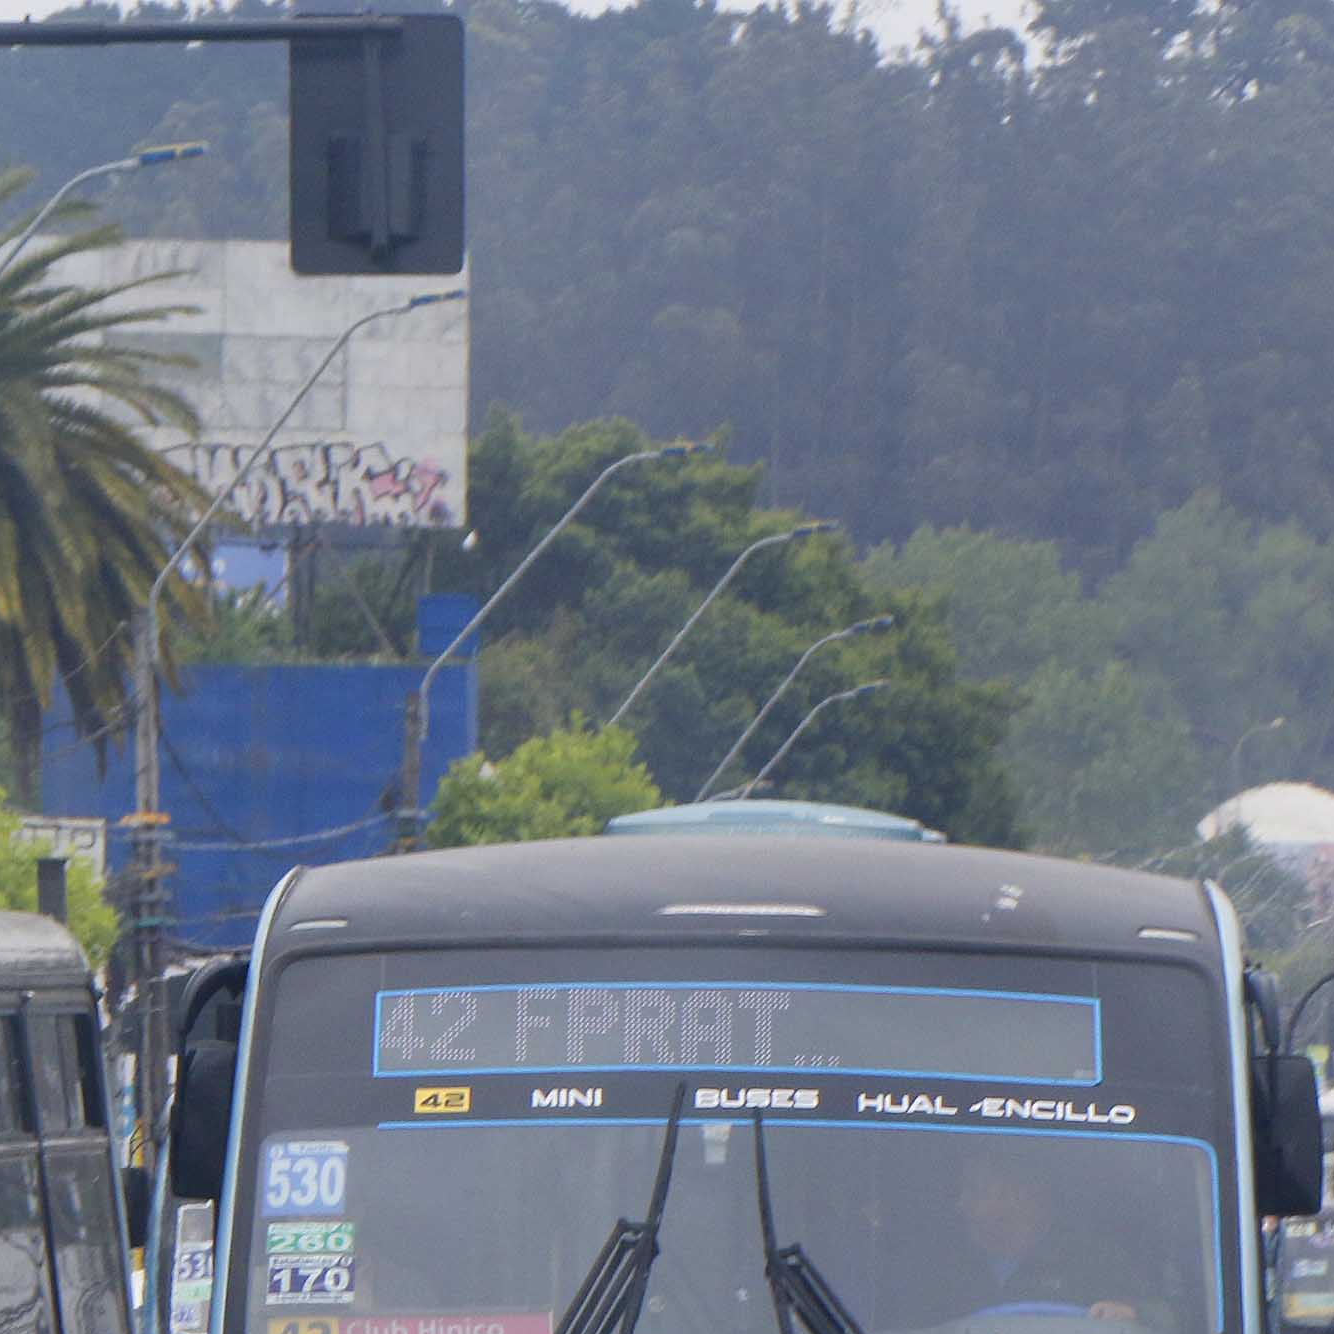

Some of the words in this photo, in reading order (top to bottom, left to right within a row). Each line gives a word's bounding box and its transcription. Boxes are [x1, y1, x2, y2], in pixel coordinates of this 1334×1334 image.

[419, 1092, 466, 1109] 42
[531, 1087, 603, 1109] MINI
[694, 1088, 819, 1110] BUSES
[268, 1156, 345, 1207] 530
[269, 1232, 353, 1252] 260
[273, 1267, 351, 1294] 170
